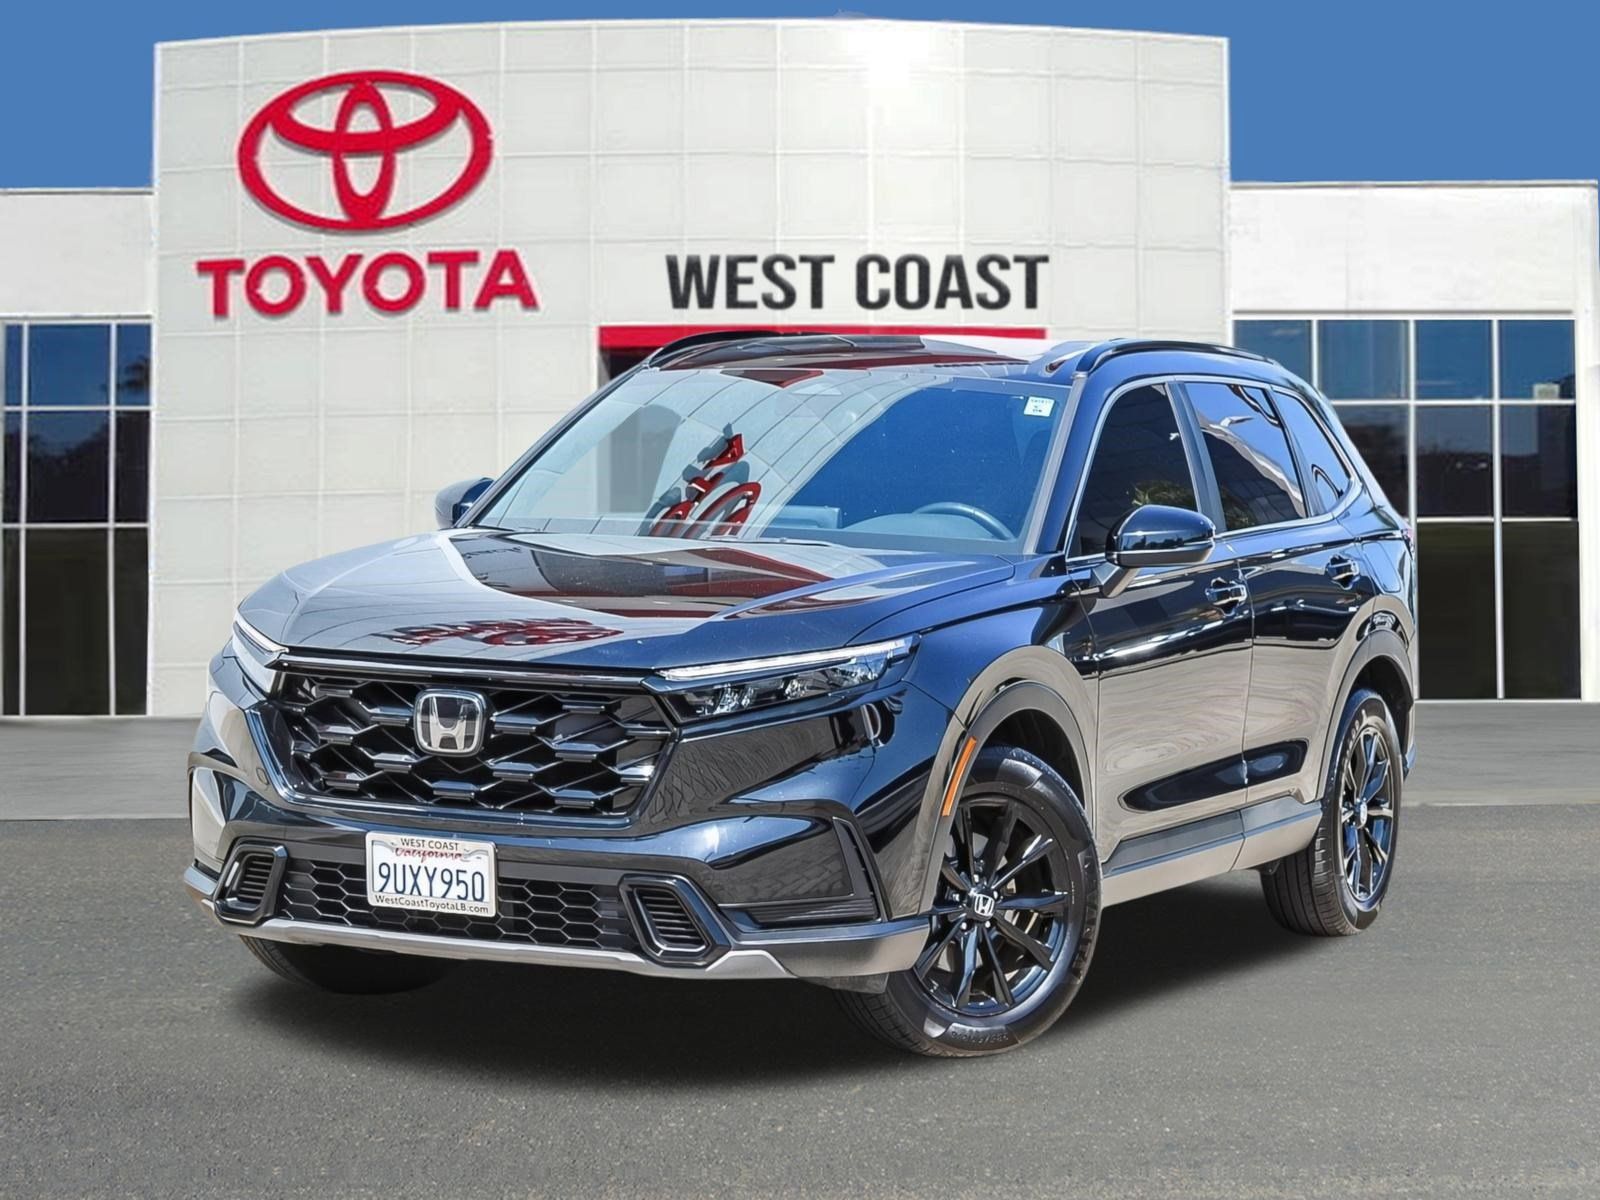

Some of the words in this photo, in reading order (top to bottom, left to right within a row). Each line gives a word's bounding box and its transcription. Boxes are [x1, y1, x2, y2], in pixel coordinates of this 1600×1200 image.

[196, 250, 540, 318] TOYOTA
[665, 253, 835, 310] WEST
[855, 253, 1050, 310] COAST
[400, 837, 426, 848] WEST
[428, 840, 460, 851] COAST
[378, 862, 485, 903] 9UXY950
[375, 895, 489, 914] WestCoastToyotaLB.com
